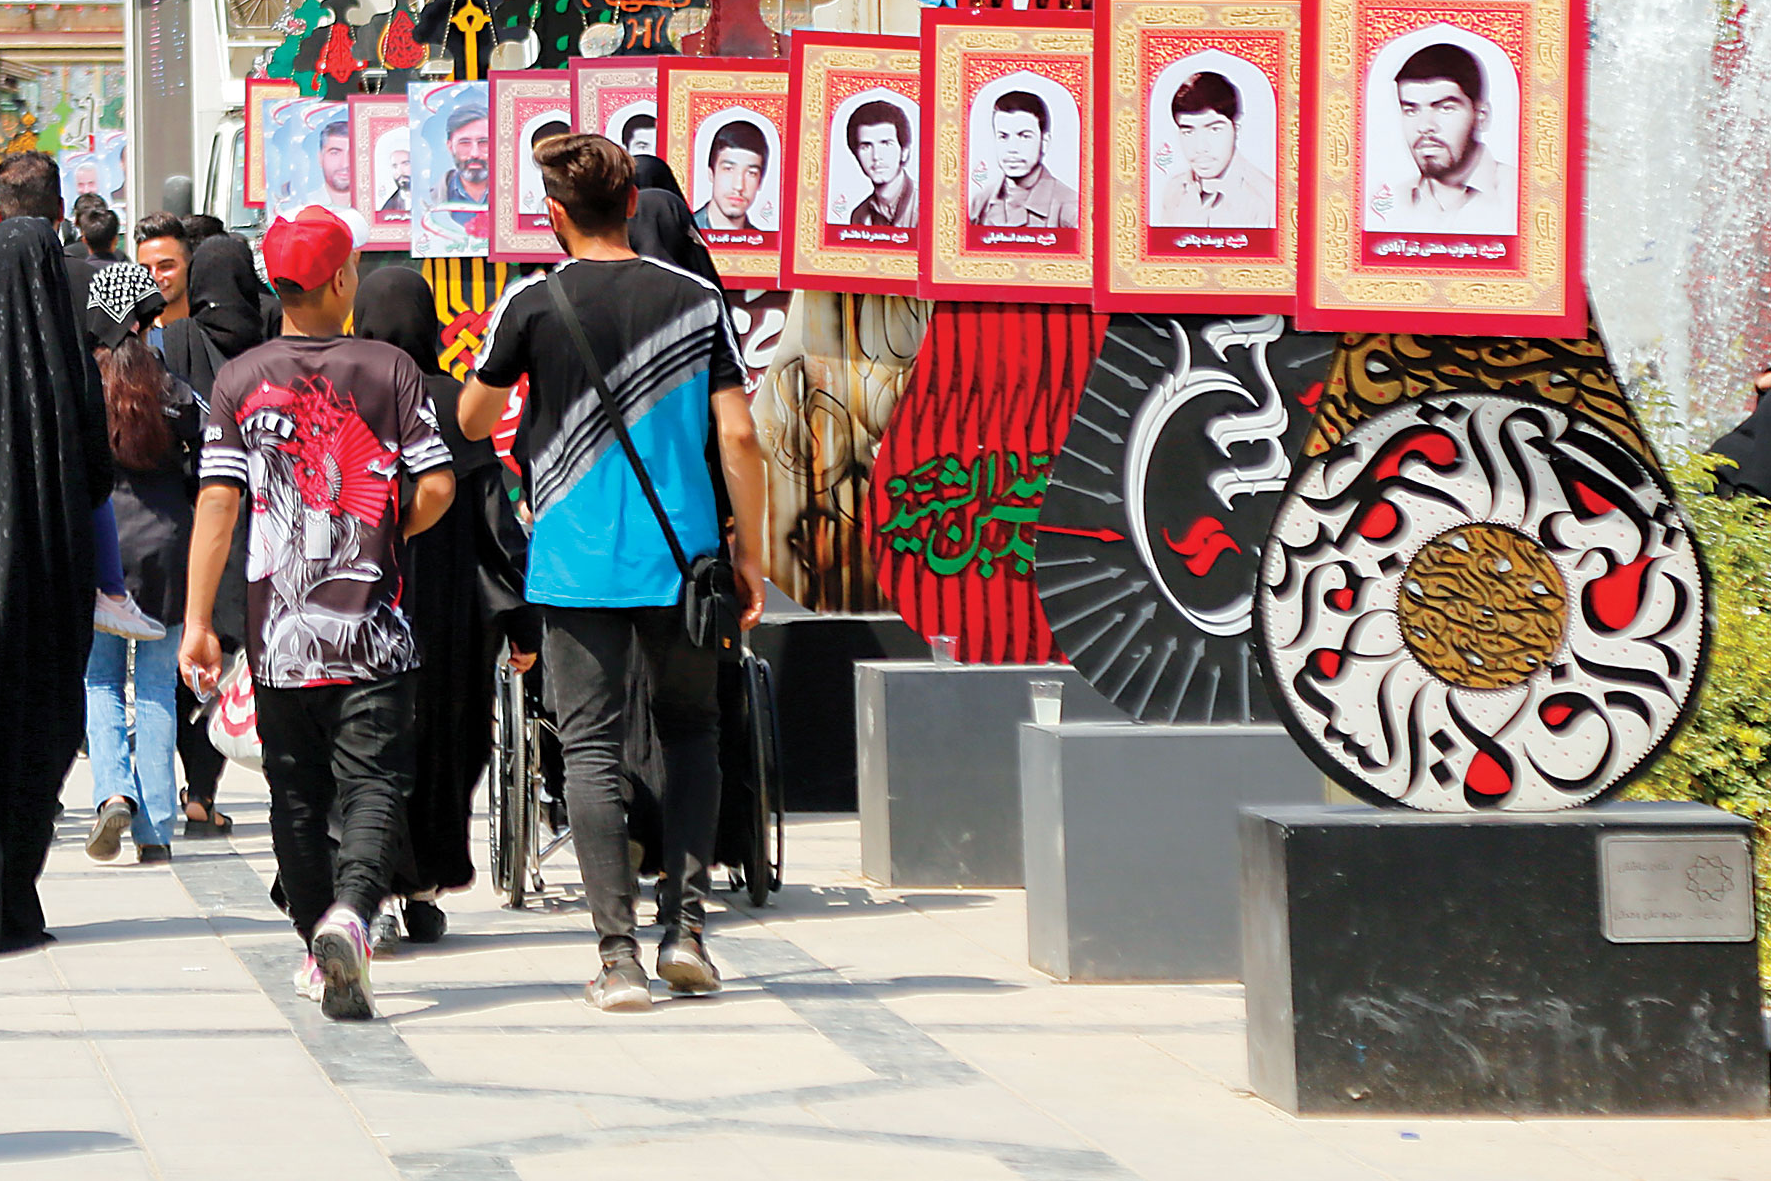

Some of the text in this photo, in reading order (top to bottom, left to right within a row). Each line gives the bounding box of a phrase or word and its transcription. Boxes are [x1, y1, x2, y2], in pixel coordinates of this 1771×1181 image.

[747, 234, 764, 245] شهید
[891, 232, 910, 244] شهید
[1036, 233, 1057, 246] شهید
[1201, 234, 1225, 249] یوسف
[1225, 234, 1248, 249] شهید
[1448, 242, 1478, 259] یعقوب
[1479, 243, 1507, 259] شهید
